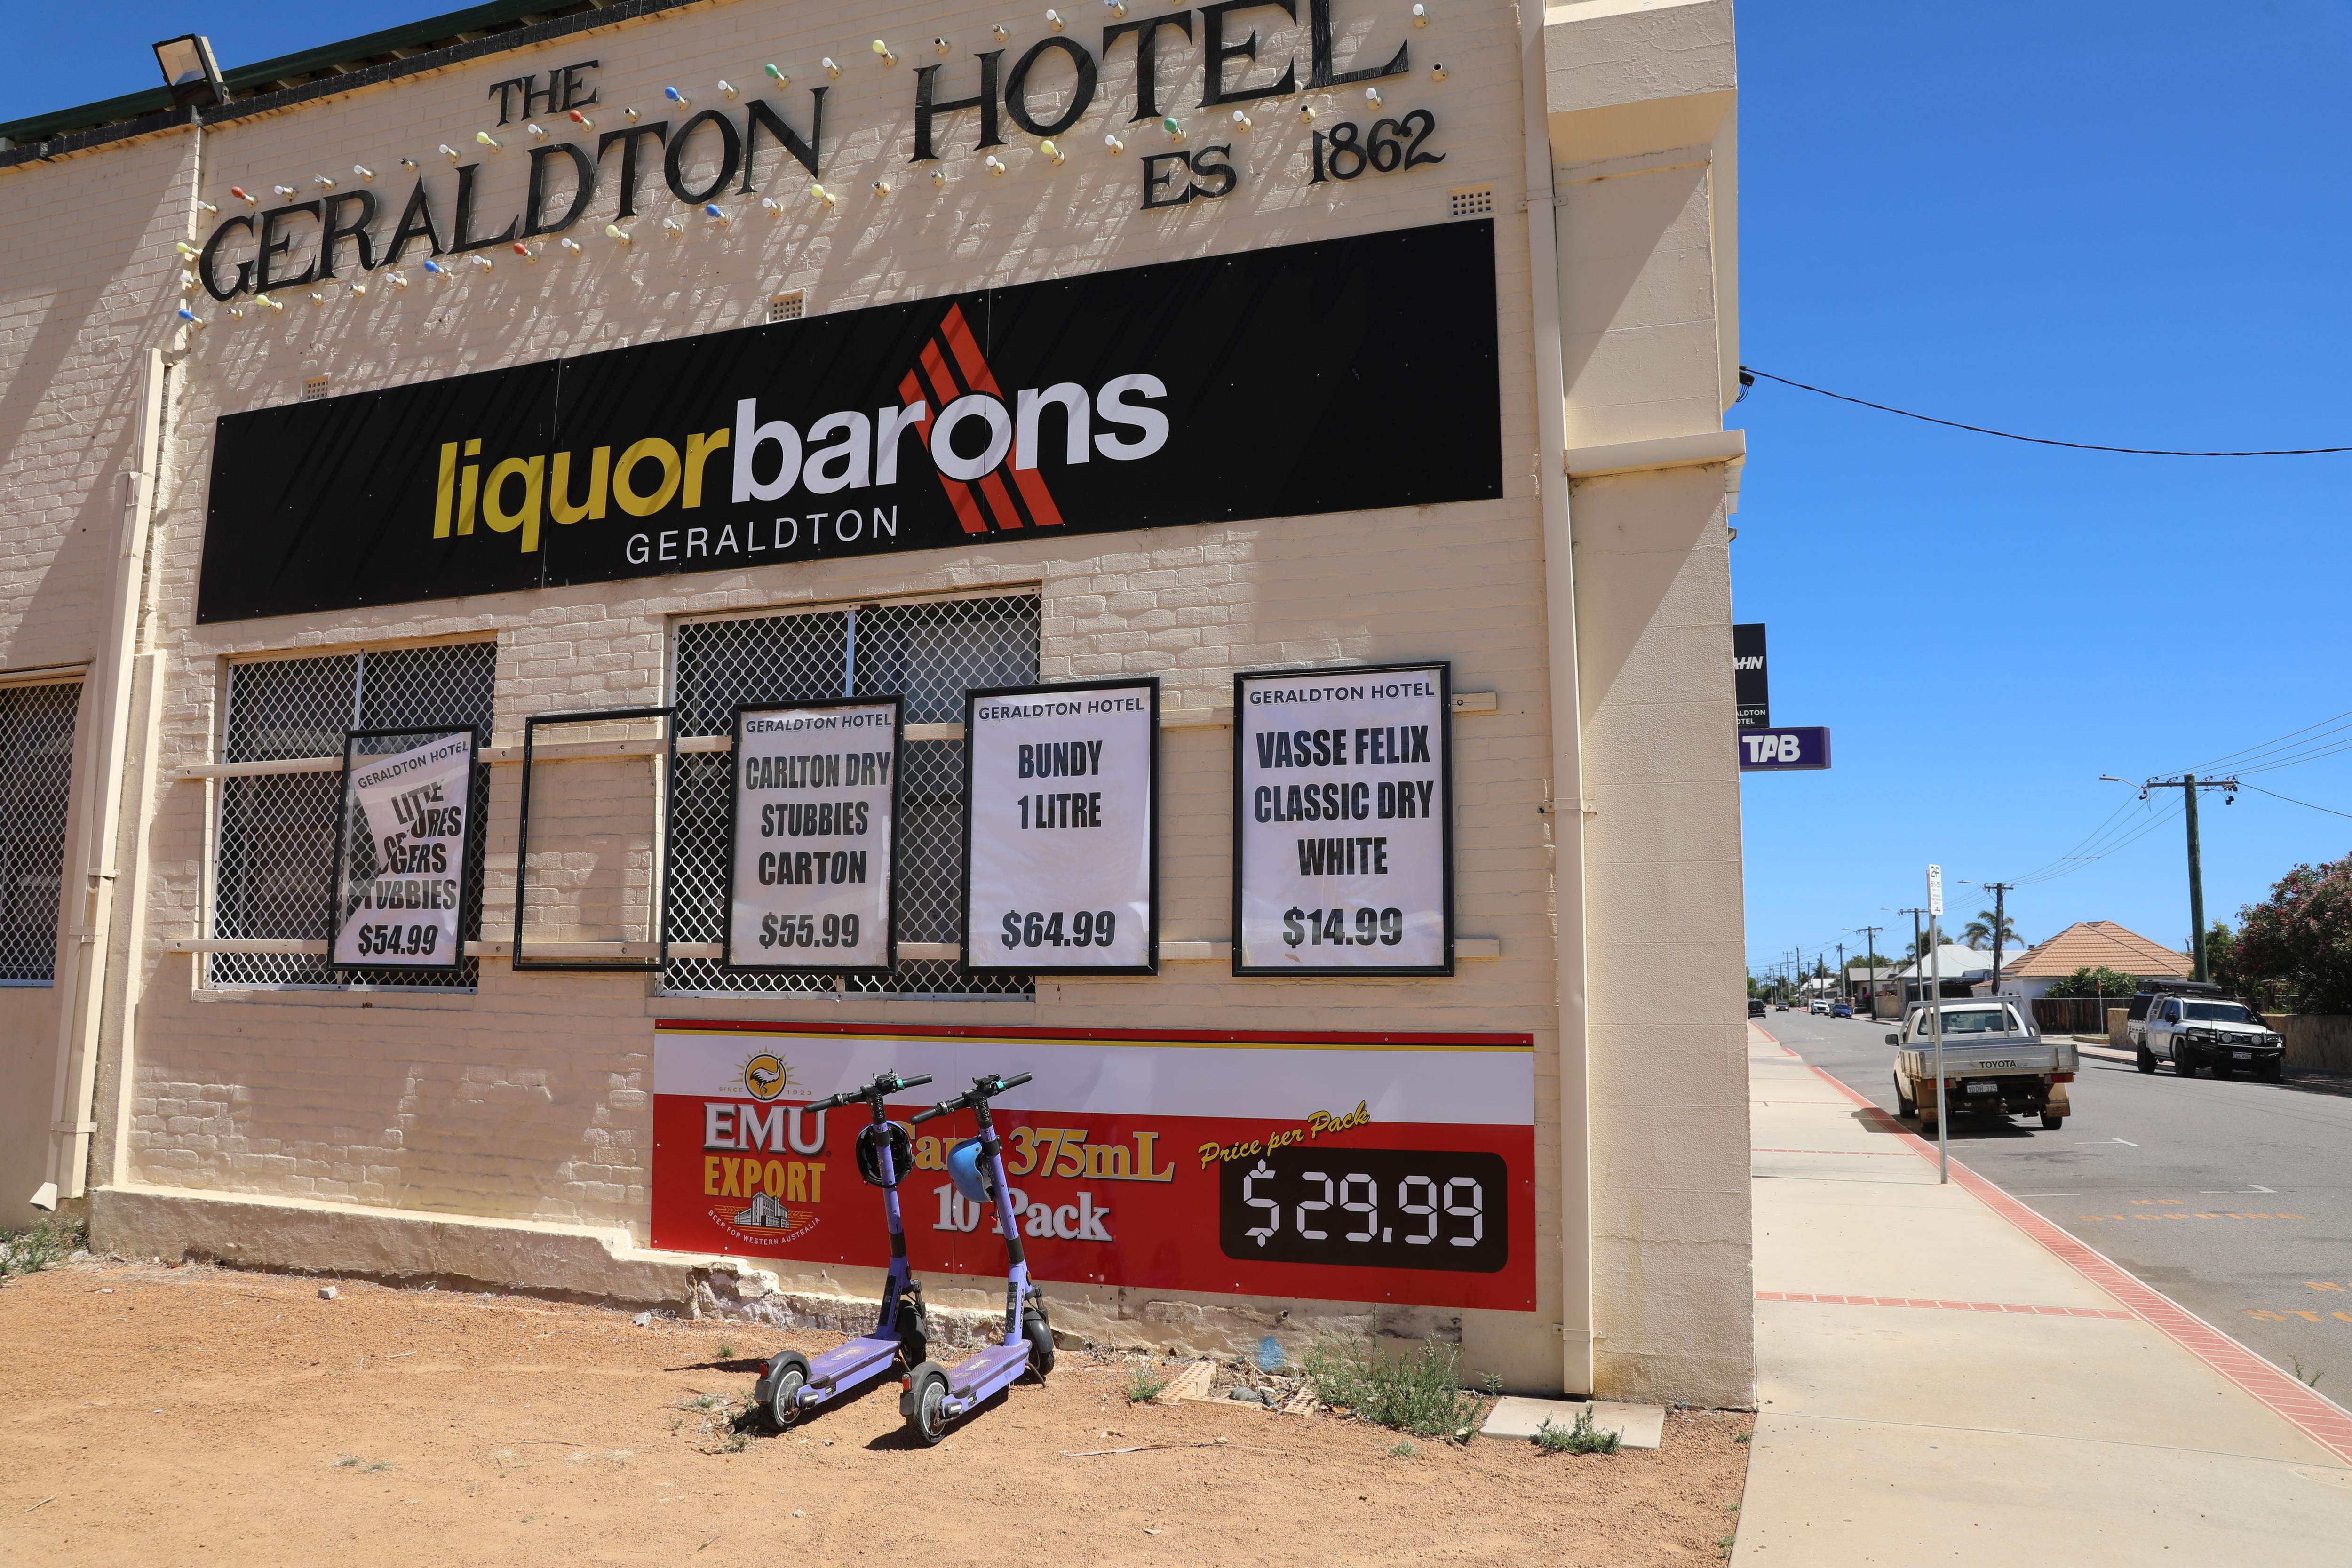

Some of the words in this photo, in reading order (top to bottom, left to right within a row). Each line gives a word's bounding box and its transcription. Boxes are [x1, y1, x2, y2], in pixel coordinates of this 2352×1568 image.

[488, 59, 600, 127] THE
[199, 86, 829, 302] GERALDTON
[908, 0, 1409, 164] HOTEL
[1140, 143, 1238, 210] ES
[1307, 109, 1446, 185] 1862
[626, 505, 898, 565] GERALDTON
[1734, 656, 1764, 670] AHN
[978, 701, 1081, 720] GERALDTON
[1088, 698, 1144, 713] HOTEL
[1250, 686, 1364, 705] GERALDTON
[1371, 682, 1435, 699] HOTEL
[746, 716, 836, 733] GERALDTON
[842, 713, 892, 728] HOTEL
[358, 755, 426, 789] GERALDTON
[430, 741, 469, 763] HOTEL
[1018, 740, 1103, 779] BUNDY
[1256, 729, 1347, 769] VASSE
[1355, 725, 1430, 765] FELIX
[1742, 735, 1801, 763] TAB
[745, 754, 840, 790] CARLTON
[845, 752, 891, 786] DRY
[761, 801, 869, 837] STUBBIES
[1017, 795, 1029, 829] 1
[1036, 792, 1101, 829] LITRE
[1255, 782, 1370, 823] CLASSIC
[1378, 780, 1434, 819] DRY
[758, 851, 867, 886] CARTON
[1297, 837, 1388, 876] WHITE
[1931, 866, 1940, 878] 2P
[358, 923, 438, 956] $54.99
[759, 912, 859, 949] $55.99
[1001, 910, 1116, 950] $64.99
[1283, 906, 1403, 949] $14.99
[1979, 1060, 2017, 1069] TOYOTA
[704, 1102, 828, 1156] EMU
[1198, 1142, 1262, 1170] Price
[1267, 1128, 1304, 1156] per
[1307, 1100, 1370, 1138] Pack
[1008, 1126, 1175, 1182] 375mL
[705, 1156, 826, 1203] EXPORT
[708, 1210, 725, 1229] BEER
[727, 1226, 741, 1239] FOR
[743, 1234, 779, 1245] WESTERN
[782, 1218, 820, 1243] AUSTRALIA
[933, 1183, 981, 1233] 10
[992, 1187, 1112, 1241] Pack
